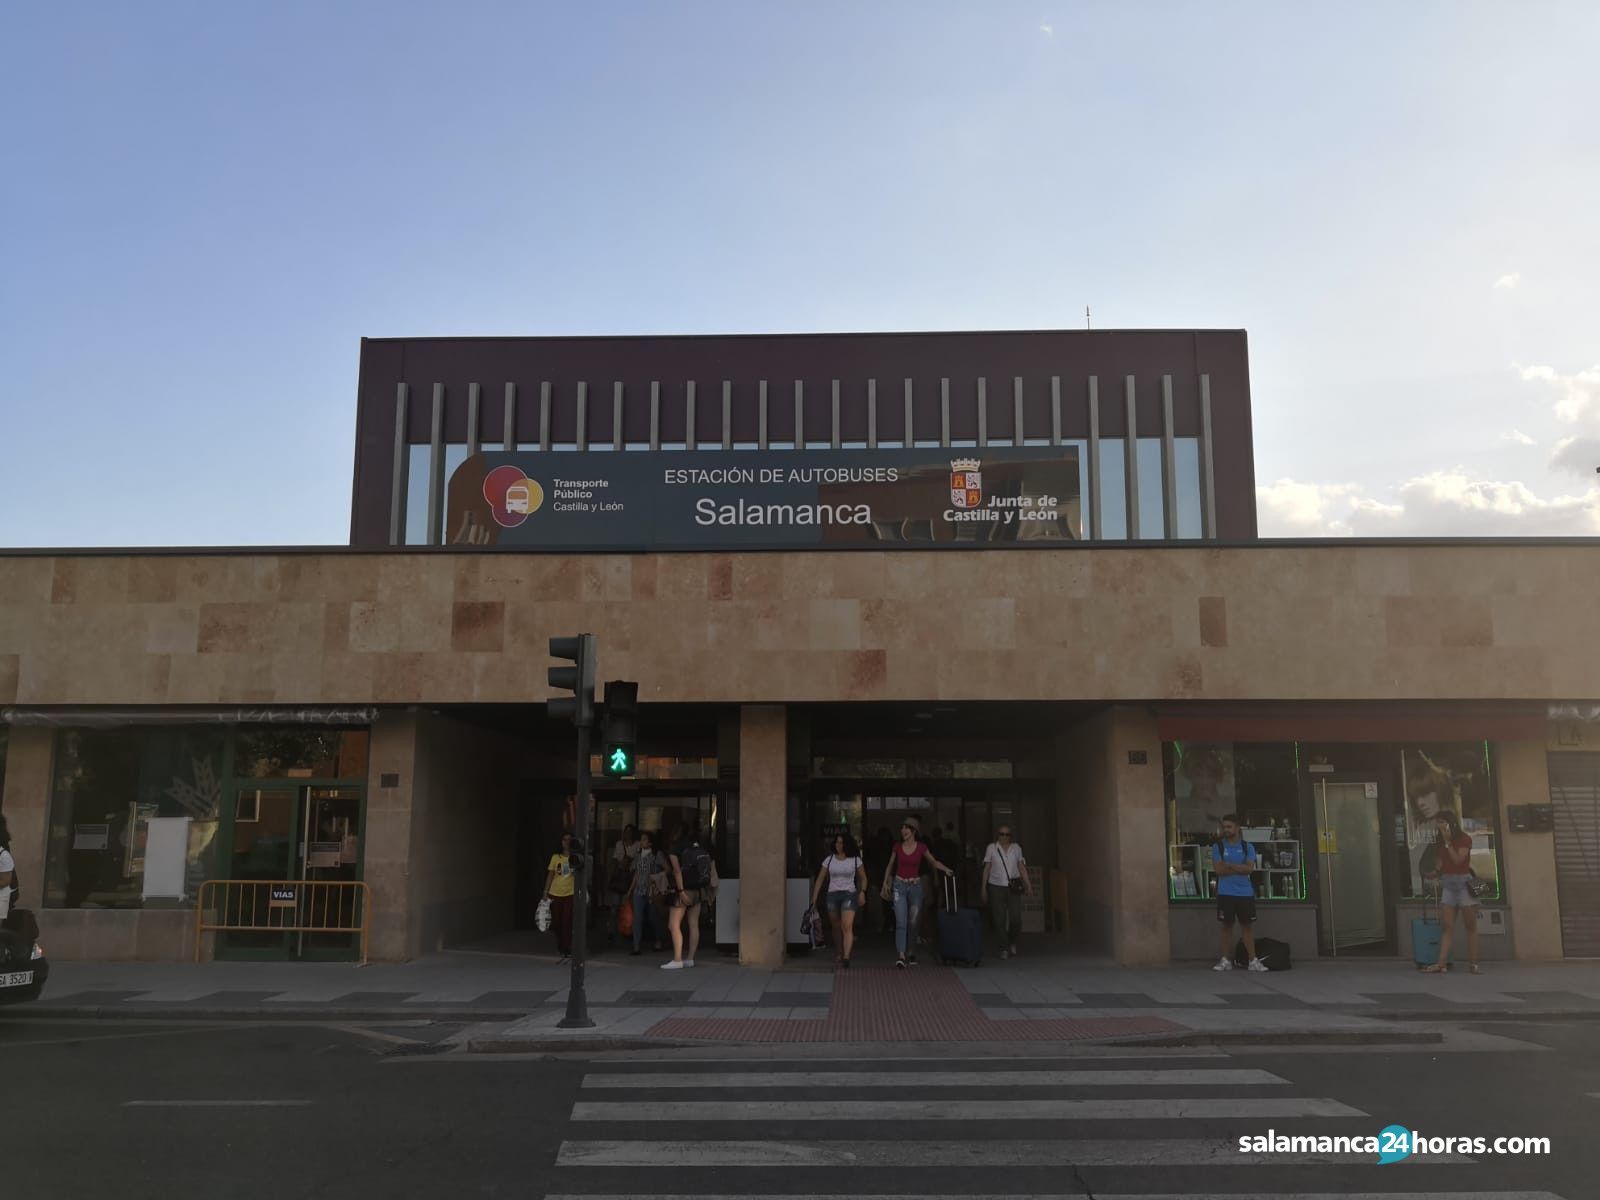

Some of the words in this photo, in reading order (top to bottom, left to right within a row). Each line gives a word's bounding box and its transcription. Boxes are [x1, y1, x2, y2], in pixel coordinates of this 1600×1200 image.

[664, 466, 755, 484] ESTACIÓN
[759, 468, 784, 483] DE
[788, 467, 898, 483] AUTOBUSES
[553, 478, 609, 490] Transporte
[553, 489, 593, 499] Público
[553, 501, 589, 511] Castilla
[591, 503, 598, 513] y
[599, 501, 624, 511] León
[987, 495, 1032, 507] Junta
[1037, 495, 1058, 507] de
[694, 498, 871, 526] Salamanca
[943, 509, 1000, 522] Castilla
[1003, 510, 1015, 525] y
[1018, 507, 1058, 521] León
[273, 891, 294, 899] VIAS
